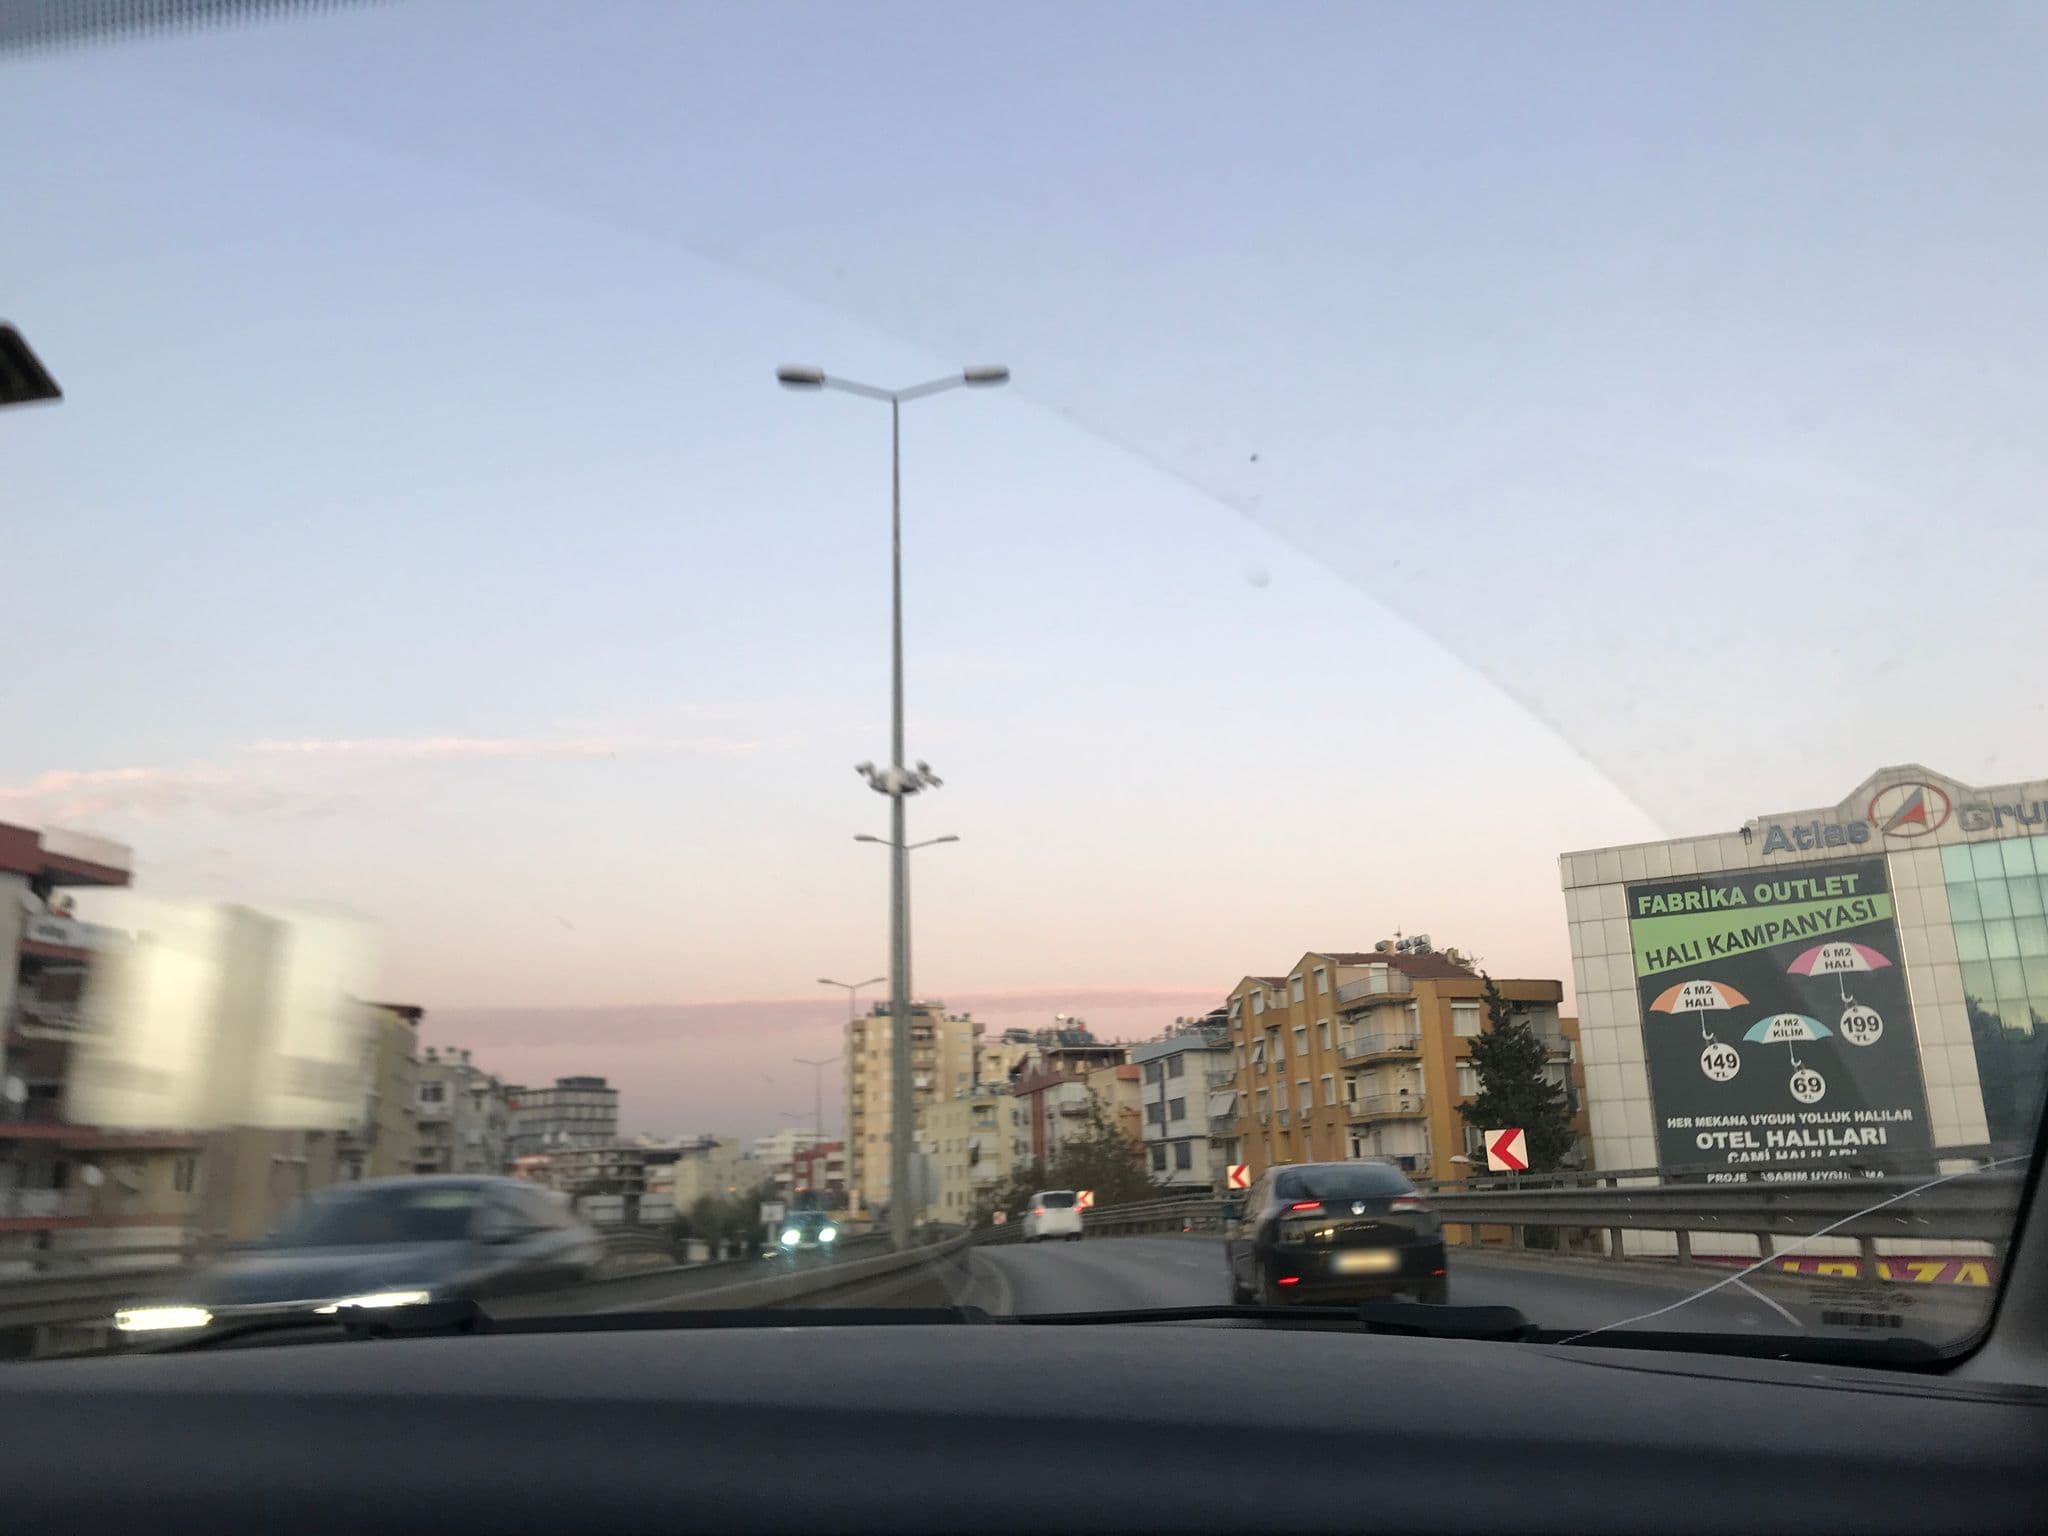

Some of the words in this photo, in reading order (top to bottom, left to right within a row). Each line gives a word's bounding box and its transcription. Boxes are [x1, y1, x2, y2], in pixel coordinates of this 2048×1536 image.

[1762, 820, 1871, 855] Atlas
[1957, 800, 2048, 832] Gru
[1637, 886, 1747, 915] FABRİKA
[1753, 873, 1859, 901] OUTLET
[1645, 940, 1702, 970] HALI
[1706, 898, 1878, 956] KAMPANYASI
[1823, 950, 1830, 958] 6
[1834, 947, 1852, 958] M2
[1824, 959, 1855, 970] HALI
[1683, 988, 1691, 996] 4
[1694, 985, 1713, 996] M2
[1685, 997, 1715, 1009] HALI
[1784, 1018, 1800, 1027] M2
[1843, 1015, 1880, 1034] 199
[1772, 1027, 1804, 1039] KİLİM
[1854, 1033, 1871, 1043] TL
[1703, 1052, 1738, 1071] 149
[1713, 1071, 1729, 1079] TL
[1793, 1076, 1822, 1094] 69
[1667, 1116, 1692, 1128] HER
[1695, 1114, 1748, 1128] MEKANA
[1750, 1112, 1796, 1125] UYGUN
[1799, 1110, 1850, 1124] YOLLUK
[1854, 1108, 1913, 1122] HALILAR
[1696, 1131, 1760, 1150] OTEL
[1766, 1126, 1887, 1148] HALILARI
[1727, 1148, 1770, 1163] CAMİ
